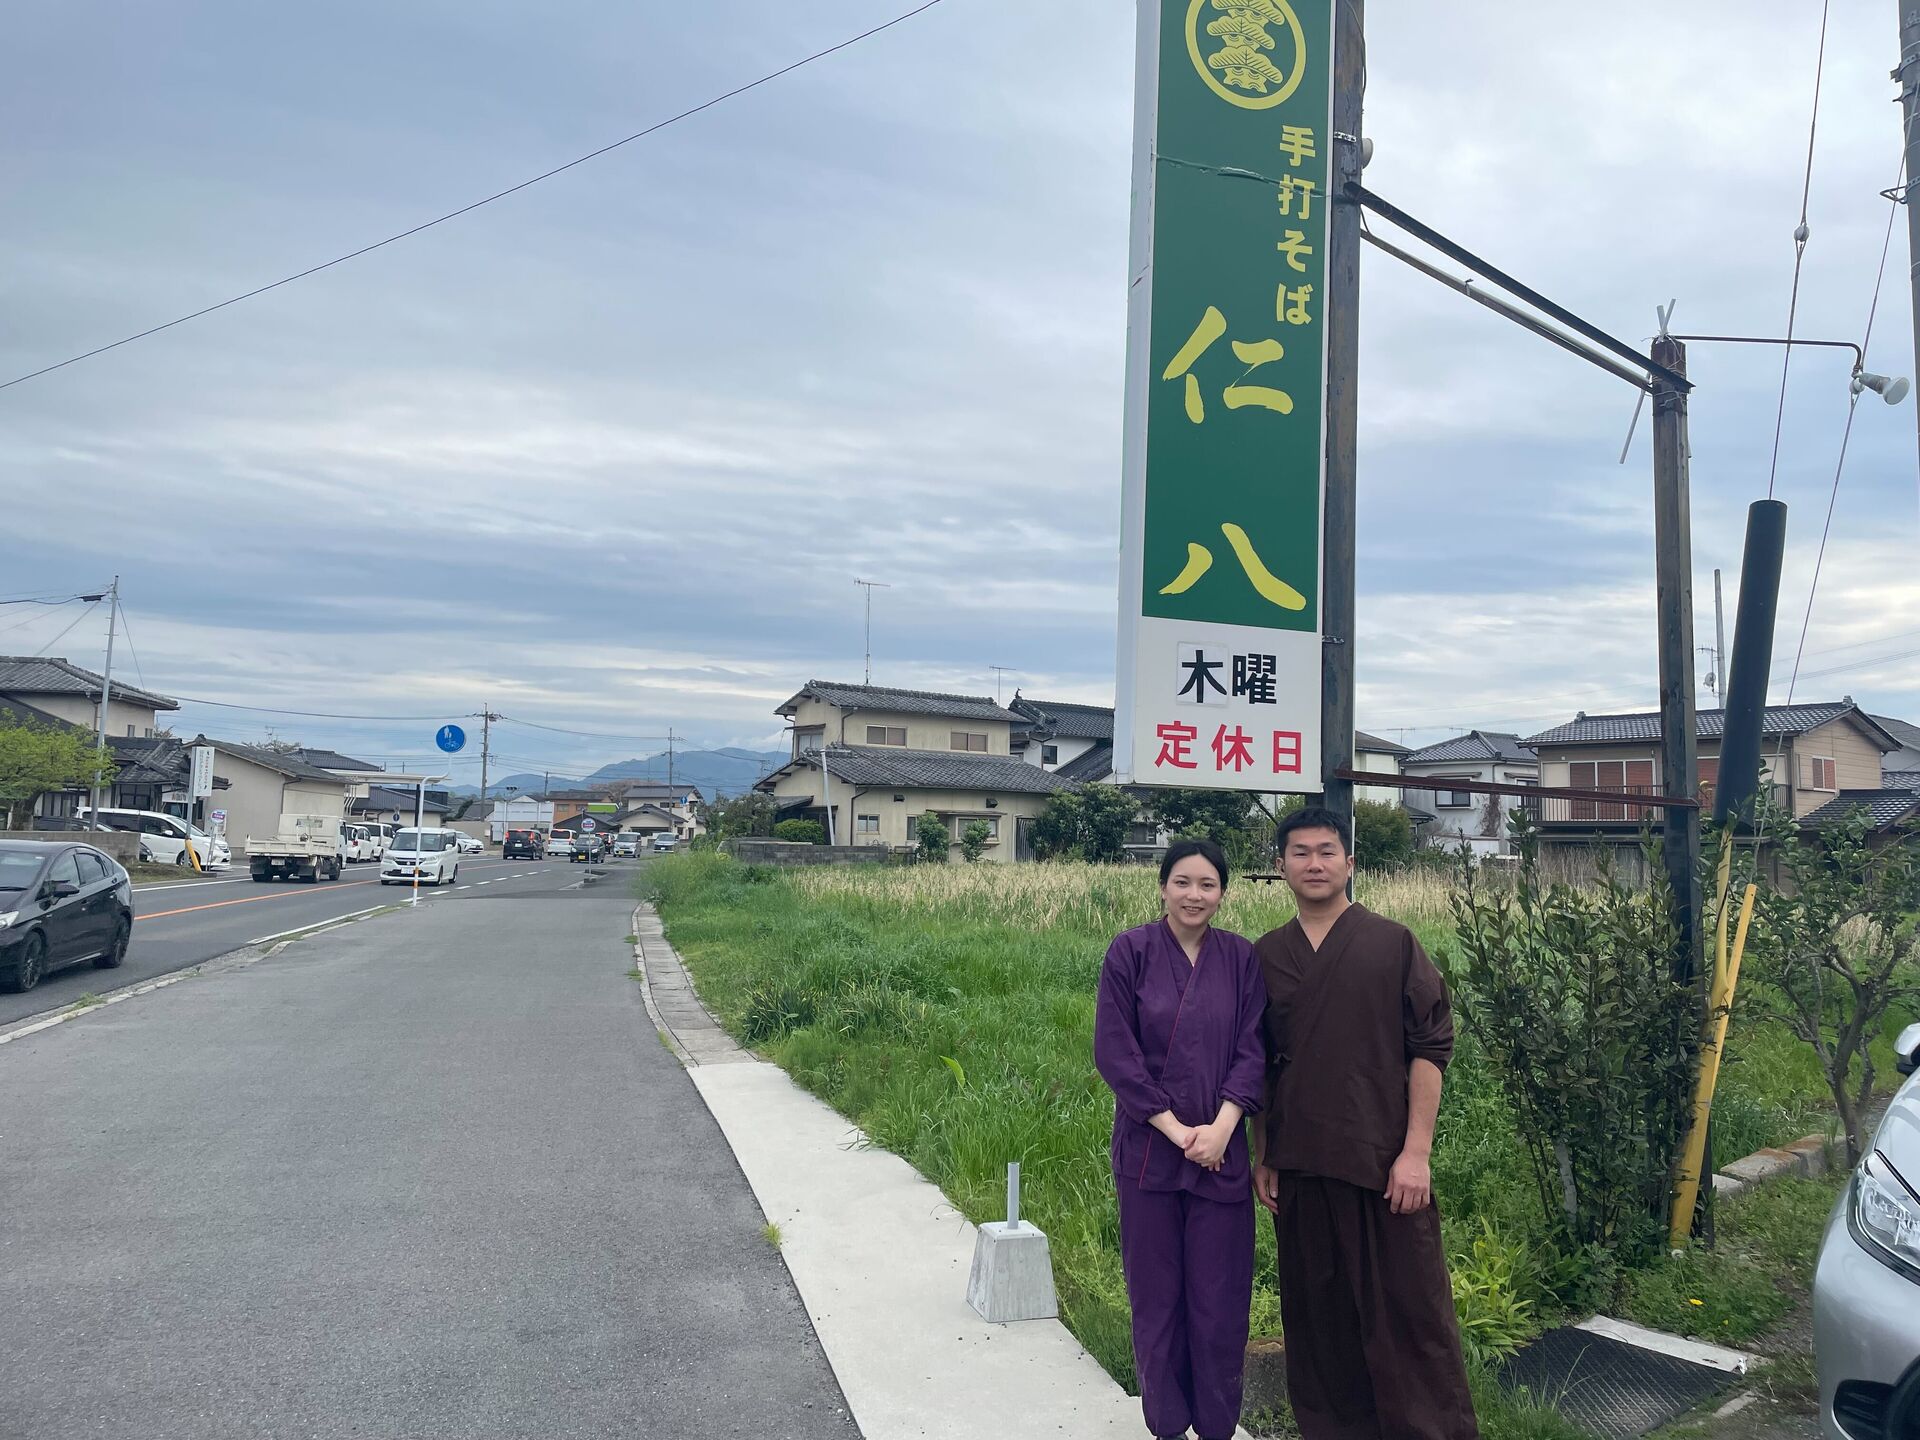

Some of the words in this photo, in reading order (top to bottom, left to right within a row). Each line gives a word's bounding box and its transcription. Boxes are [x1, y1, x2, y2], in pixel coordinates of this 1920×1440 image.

[1277, 125, 1316, 325] 手打そば
[1158, 306, 1306, 610] 仁八
[1178, 650, 1277, 704] 木曜
[1155, 721, 1302, 774] 定休日
